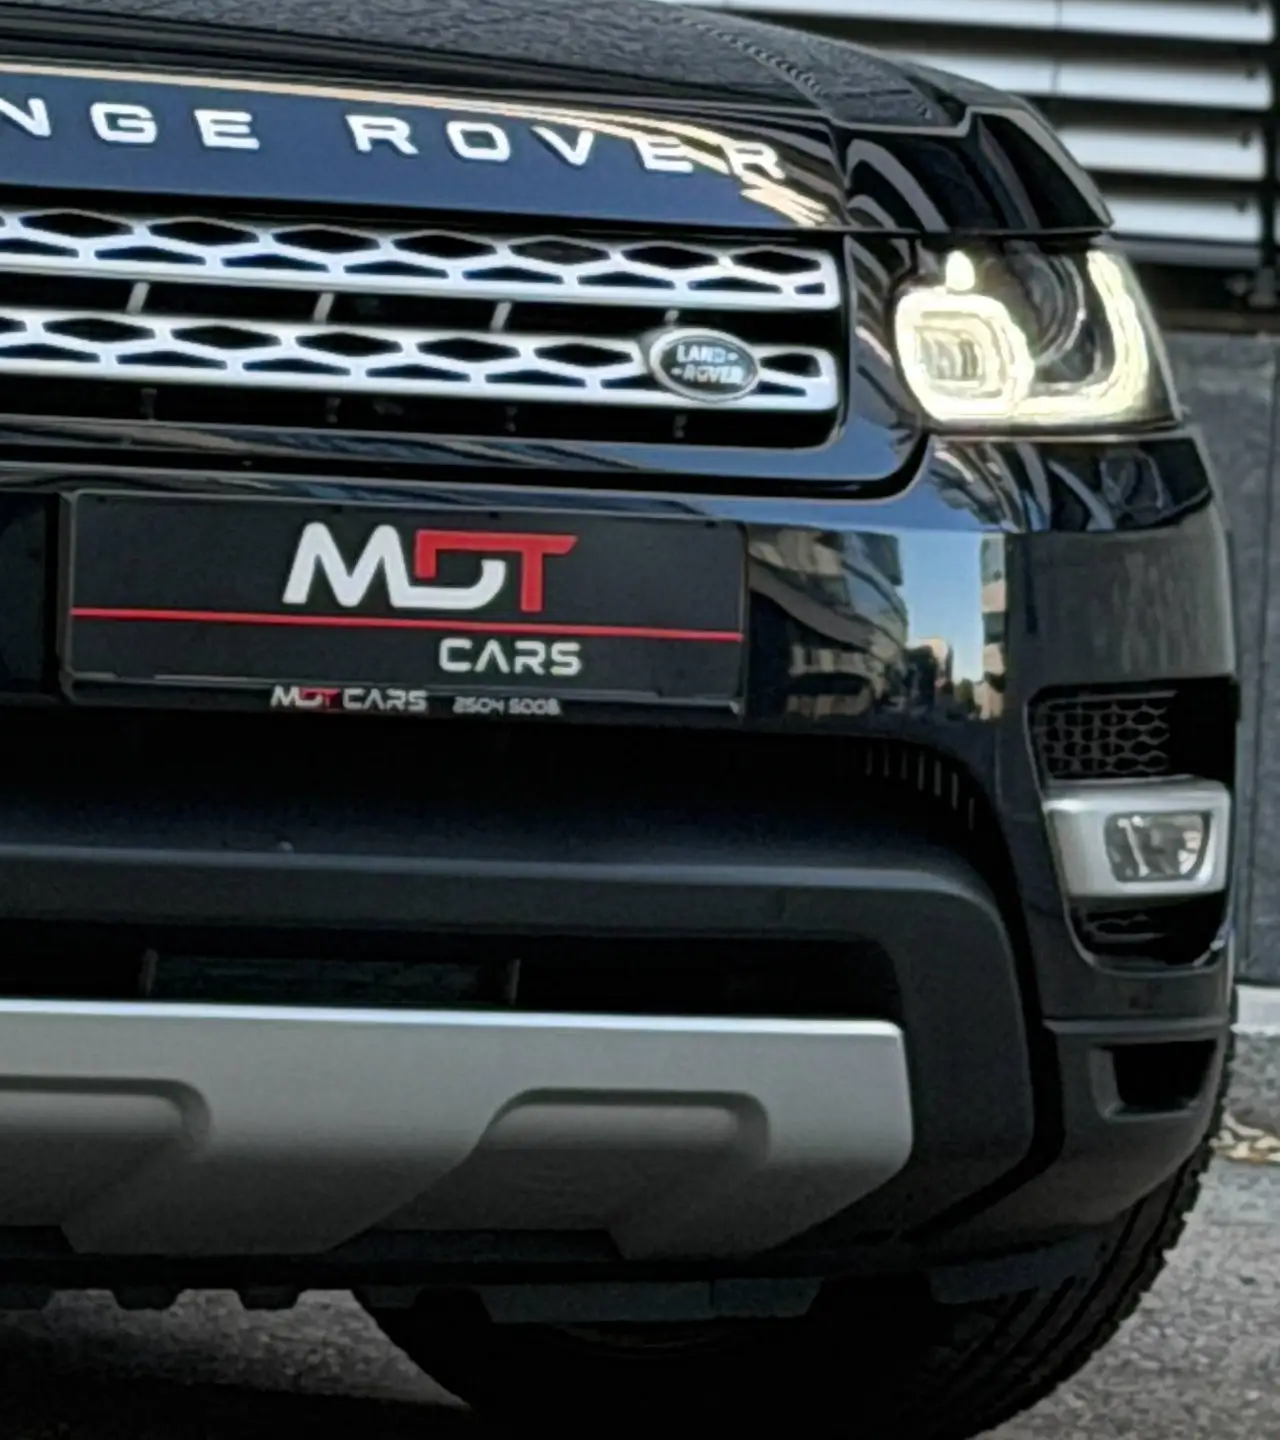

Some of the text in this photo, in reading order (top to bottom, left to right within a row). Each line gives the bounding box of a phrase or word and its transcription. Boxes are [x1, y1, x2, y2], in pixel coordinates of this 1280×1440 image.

[345, 114, 787, 180] ROVER
[676, 344, 727, 364] LAND
[282, 521, 578, 613] MDT
[438, 637, 583, 677] CARS
[270, 685, 340, 707] MDT
[342, 687, 428, 711] CARS
